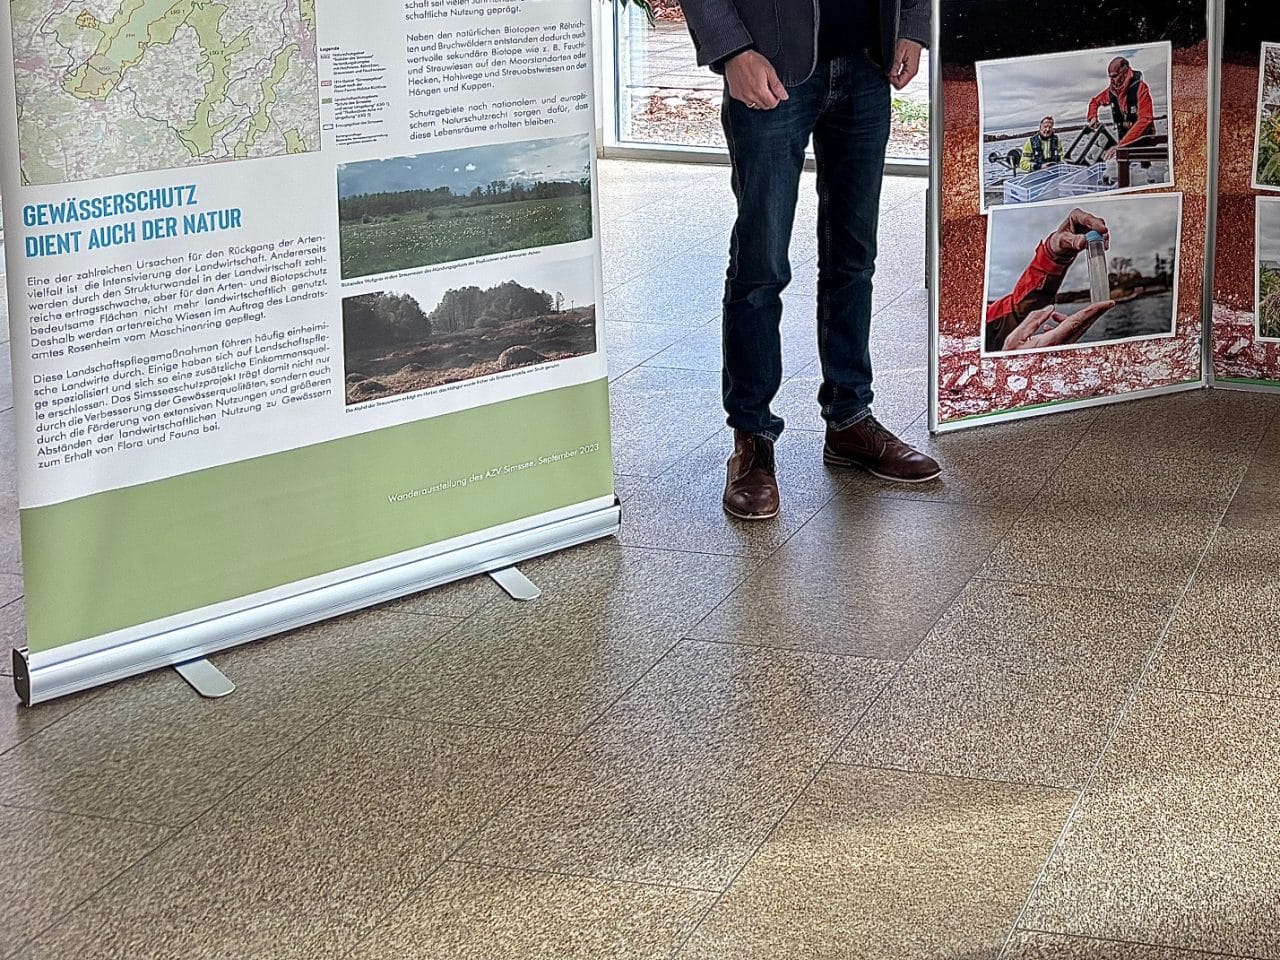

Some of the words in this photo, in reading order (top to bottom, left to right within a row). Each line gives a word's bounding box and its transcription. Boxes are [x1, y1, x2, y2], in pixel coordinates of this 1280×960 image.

[23, 184, 198, 228] GEWÄSSERSCHUTZ
[25, 232, 82, 258] DIENT
[87, 225, 136, 250] AUCH
[142, 219, 178, 241] DER
[182, 207, 241, 236] NATUR
[27, 276, 50, 286] Eine
[54, 273, 72, 282] der
[76, 263, 132, 279] zahlreichen
[136, 255, 184, 269] Ursachen
[188, 252, 202, 262] für
[205, 249, 224, 259] den
[228, 242, 274, 255] Rückgang
[278, 238, 294, 248] der
[296, 235, 325, 245] Arten-
[27, 285, 62, 298] vielfalt
[66, 282, 77, 292] ist
[84, 279, 99, 289] die
[102, 269, 171, 286] Intensivierung
[174, 266, 192, 275] der
[194, 254, 266, 272] Landwirtschaft.
[270, 244, 326, 260] Andererseits
[388, 476, 467, 503] Wanderausstellung
[469, 473, 483, 483] des
[485, 467, 501, 480] AZV
[503, 460, 537, 474] Simssee,
[538, 450, 578, 467] September
[579, 443, 599, 456] 2023
